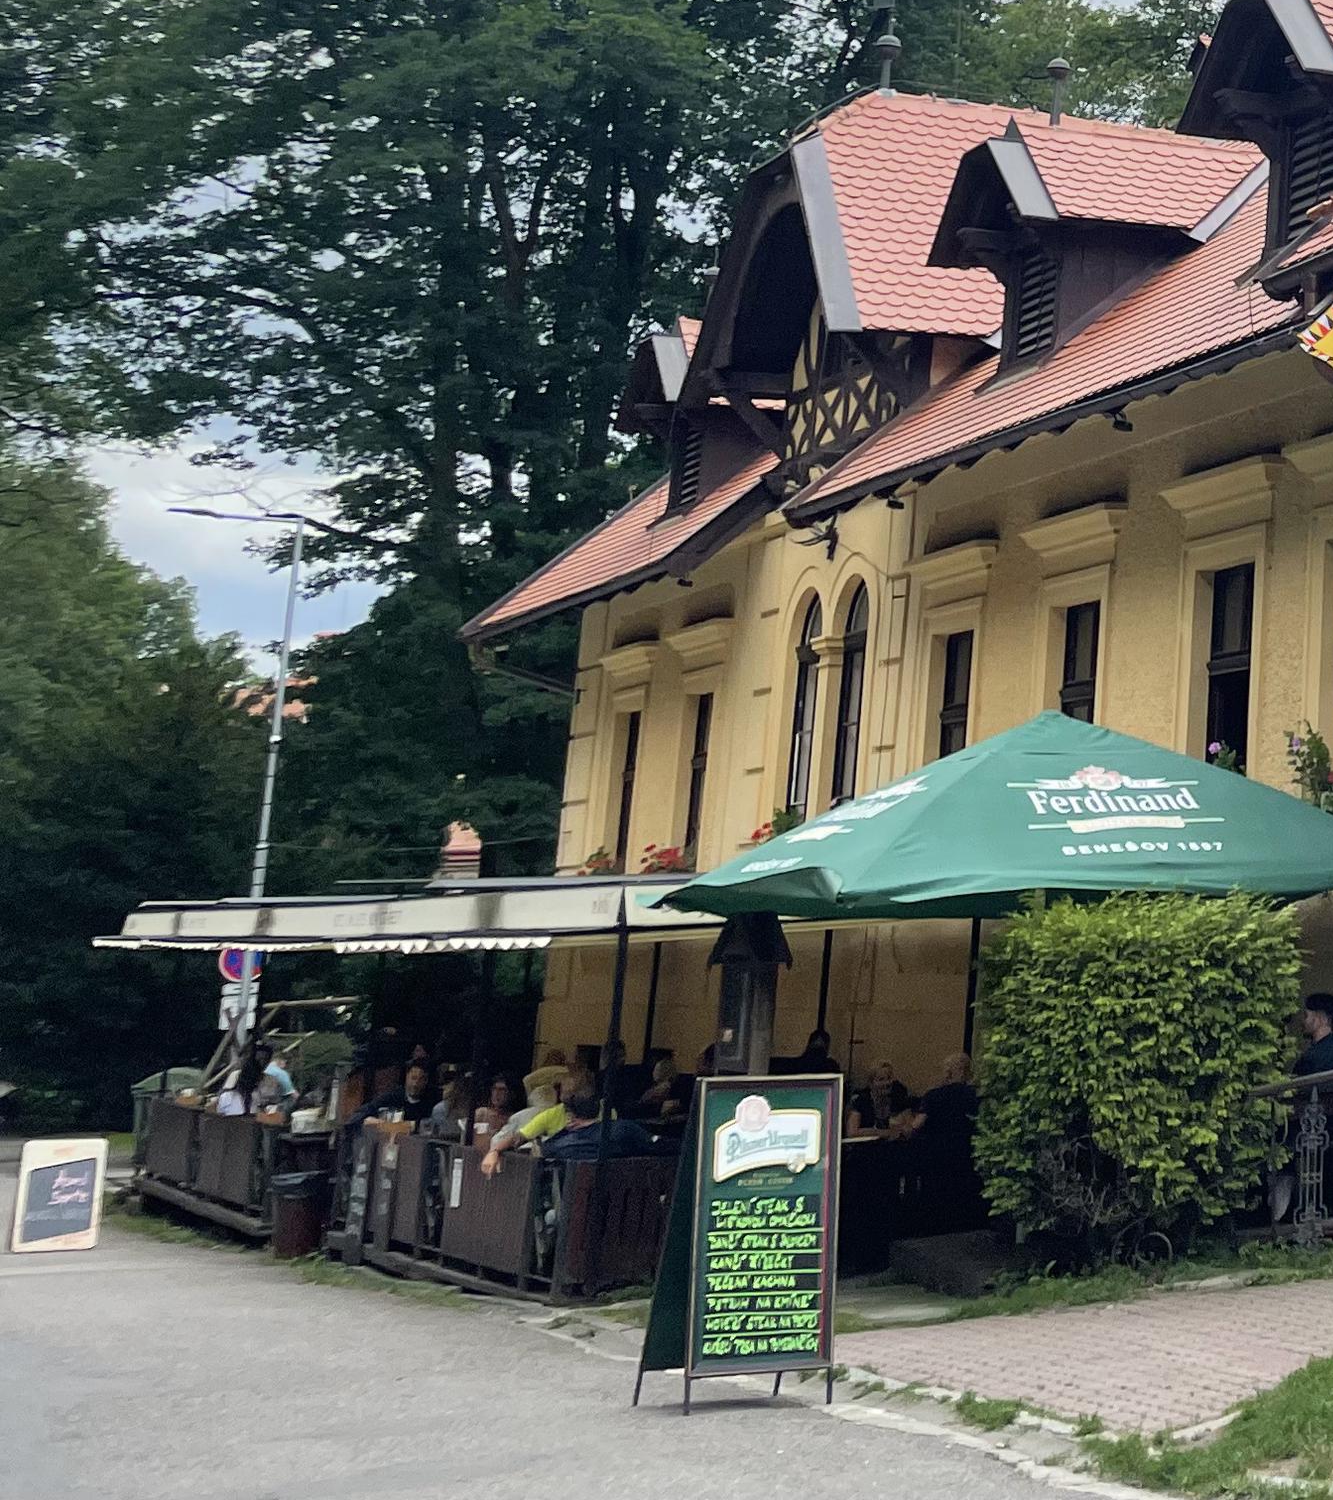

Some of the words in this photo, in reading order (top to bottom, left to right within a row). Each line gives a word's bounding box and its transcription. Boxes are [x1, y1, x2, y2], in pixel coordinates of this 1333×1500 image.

[1027, 787, 1200, 815] Ferdinand
[1061, 840, 1169, 856] BENEŠOV
[755, 1296, 772, 1309] NA
